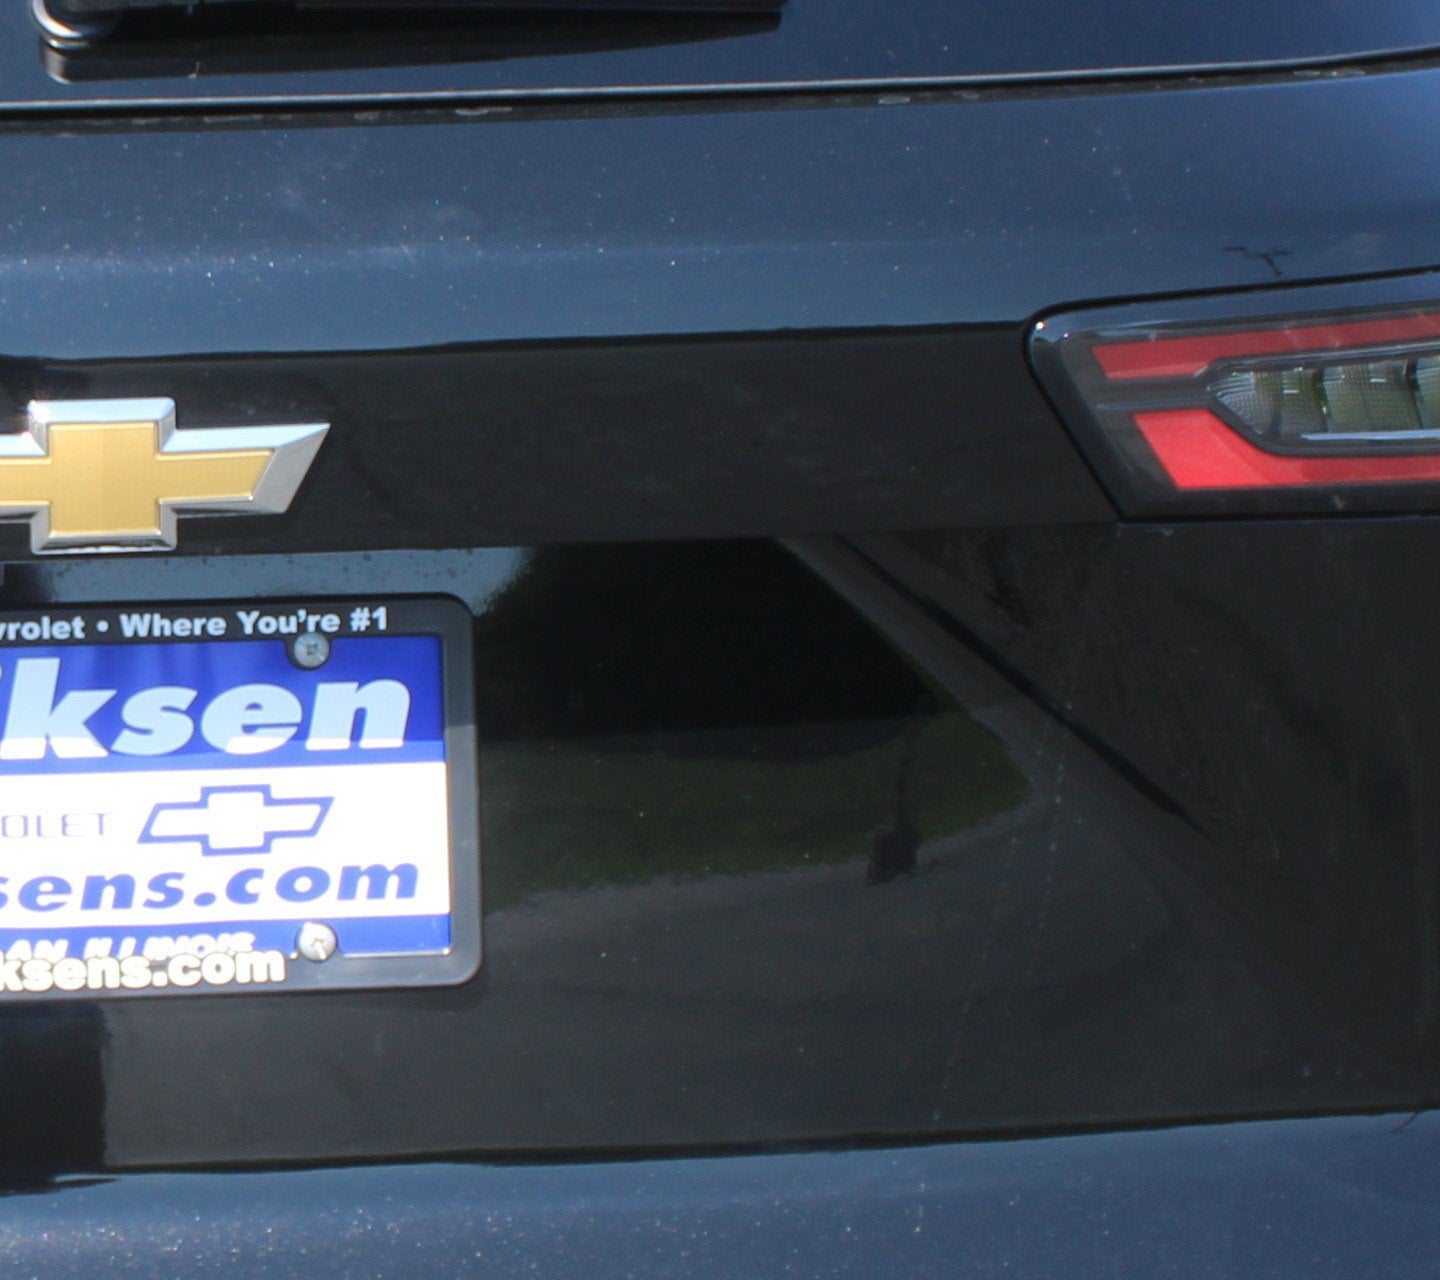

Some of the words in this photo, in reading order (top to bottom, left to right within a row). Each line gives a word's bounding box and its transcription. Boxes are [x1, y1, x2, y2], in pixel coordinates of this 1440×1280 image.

[119, 612, 227, 639] Where
[235, 608, 342, 636] You're
[349, 606, 389, 632] #1
